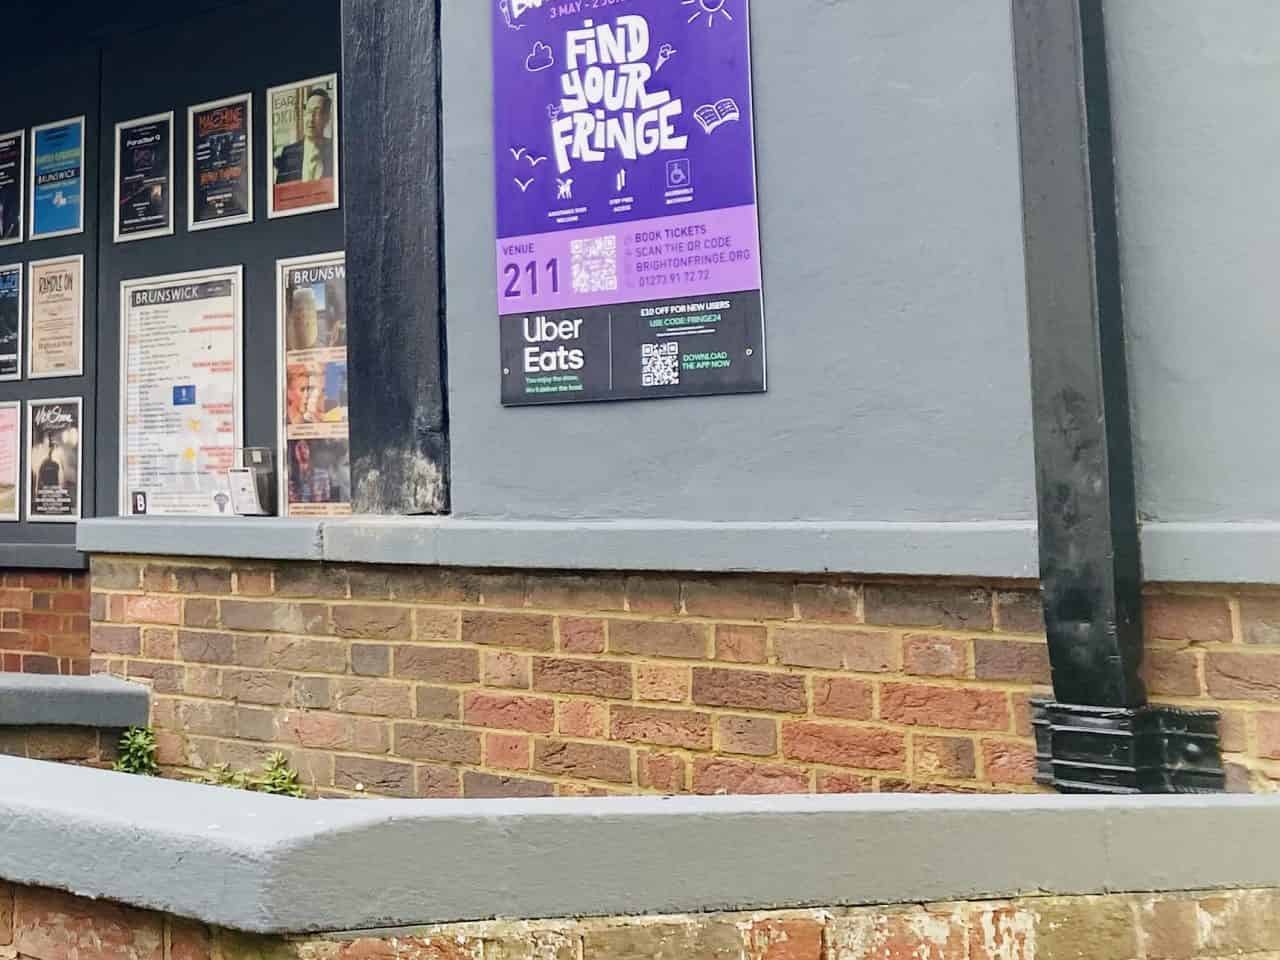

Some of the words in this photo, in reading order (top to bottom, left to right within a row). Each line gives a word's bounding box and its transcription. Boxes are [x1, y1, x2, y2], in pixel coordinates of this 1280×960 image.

[550, 7, 556, 18] 3
[558, 0, 582, 17] MAY
[561, 63, 670, 112] YOUR
[551, 98, 688, 174] FRINGE
[635, 230, 662, 243] BOOK
[664, 224, 706, 239] TICKETS
[502, 243, 535, 256] VENUE
[636, 245, 662, 257] SCAN
[665, 242, 685, 254] THE
[687, 240, 701, 251] QR
[704, 236, 732, 249] CODE
[636, 248, 751, 272] BRIGHTONFRINGE.ORG
[503, 257, 559, 298] 211
[639, 274, 667, 287] 01273
[670, 273, 681, 284] 91
[135, 286, 199, 305] BRUNSWICK
[687, 303, 705, 312] NEW
[706, 300, 730, 310] USERS
[523, 315, 583, 342] Uber
[524, 345, 585, 373] Eats
[683, 351, 727, 361] DOWNLOAD
[711, 360, 731, 368] NOW
